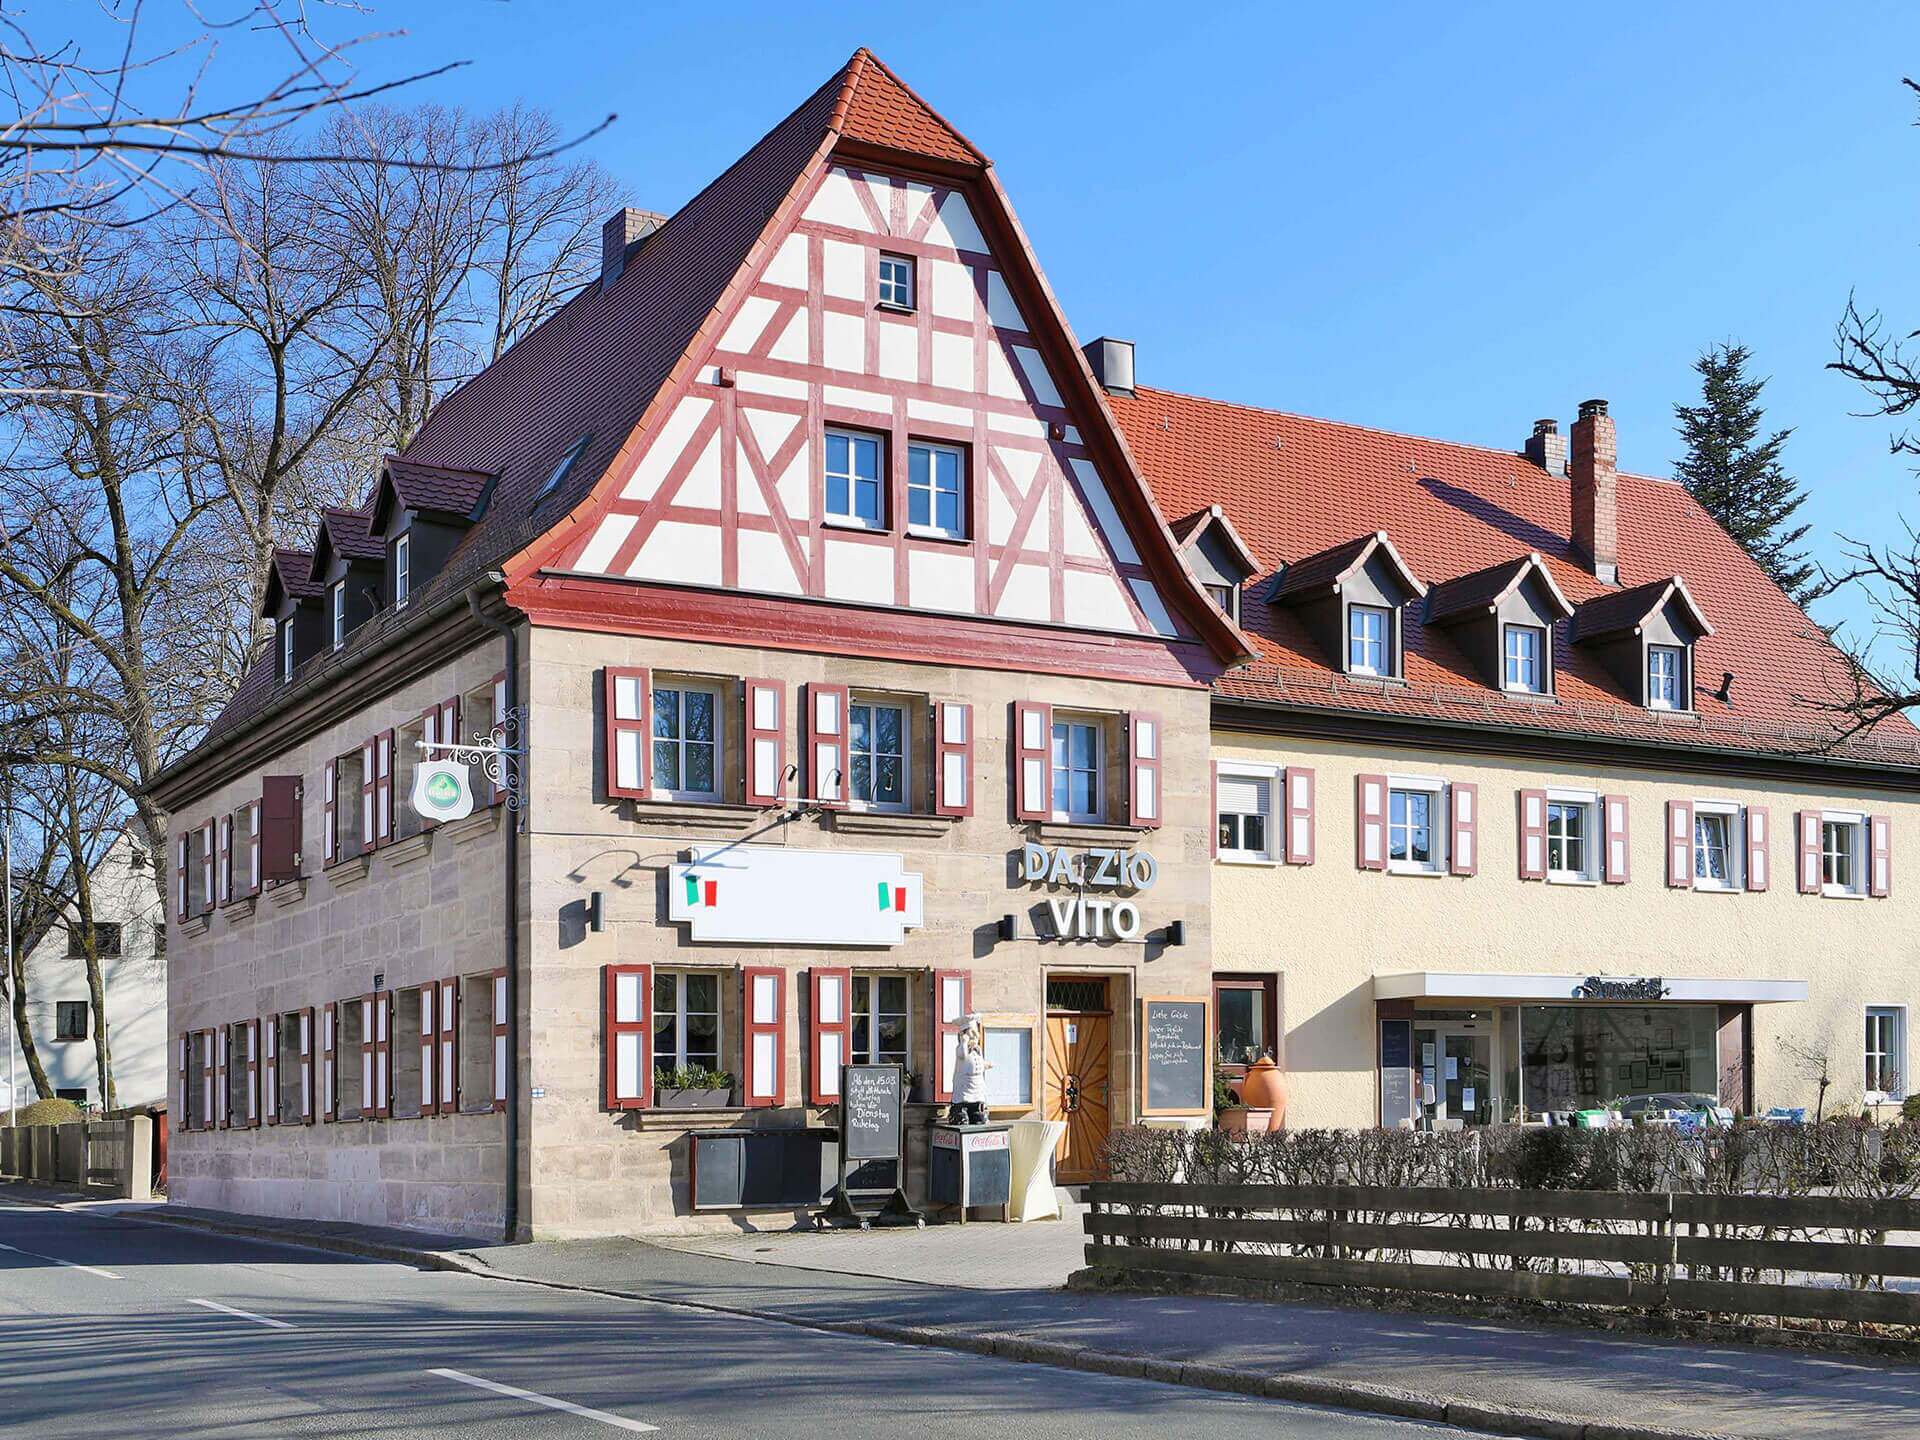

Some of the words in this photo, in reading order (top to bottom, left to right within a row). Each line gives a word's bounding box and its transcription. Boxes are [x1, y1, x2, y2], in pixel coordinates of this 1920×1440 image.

[1025, 842, 1077, 885] DA
[1089, 848, 1158, 890] ZIO
[1049, 899, 1141, 938] VITO
[856, 1108, 890, 1123] Dienstag
